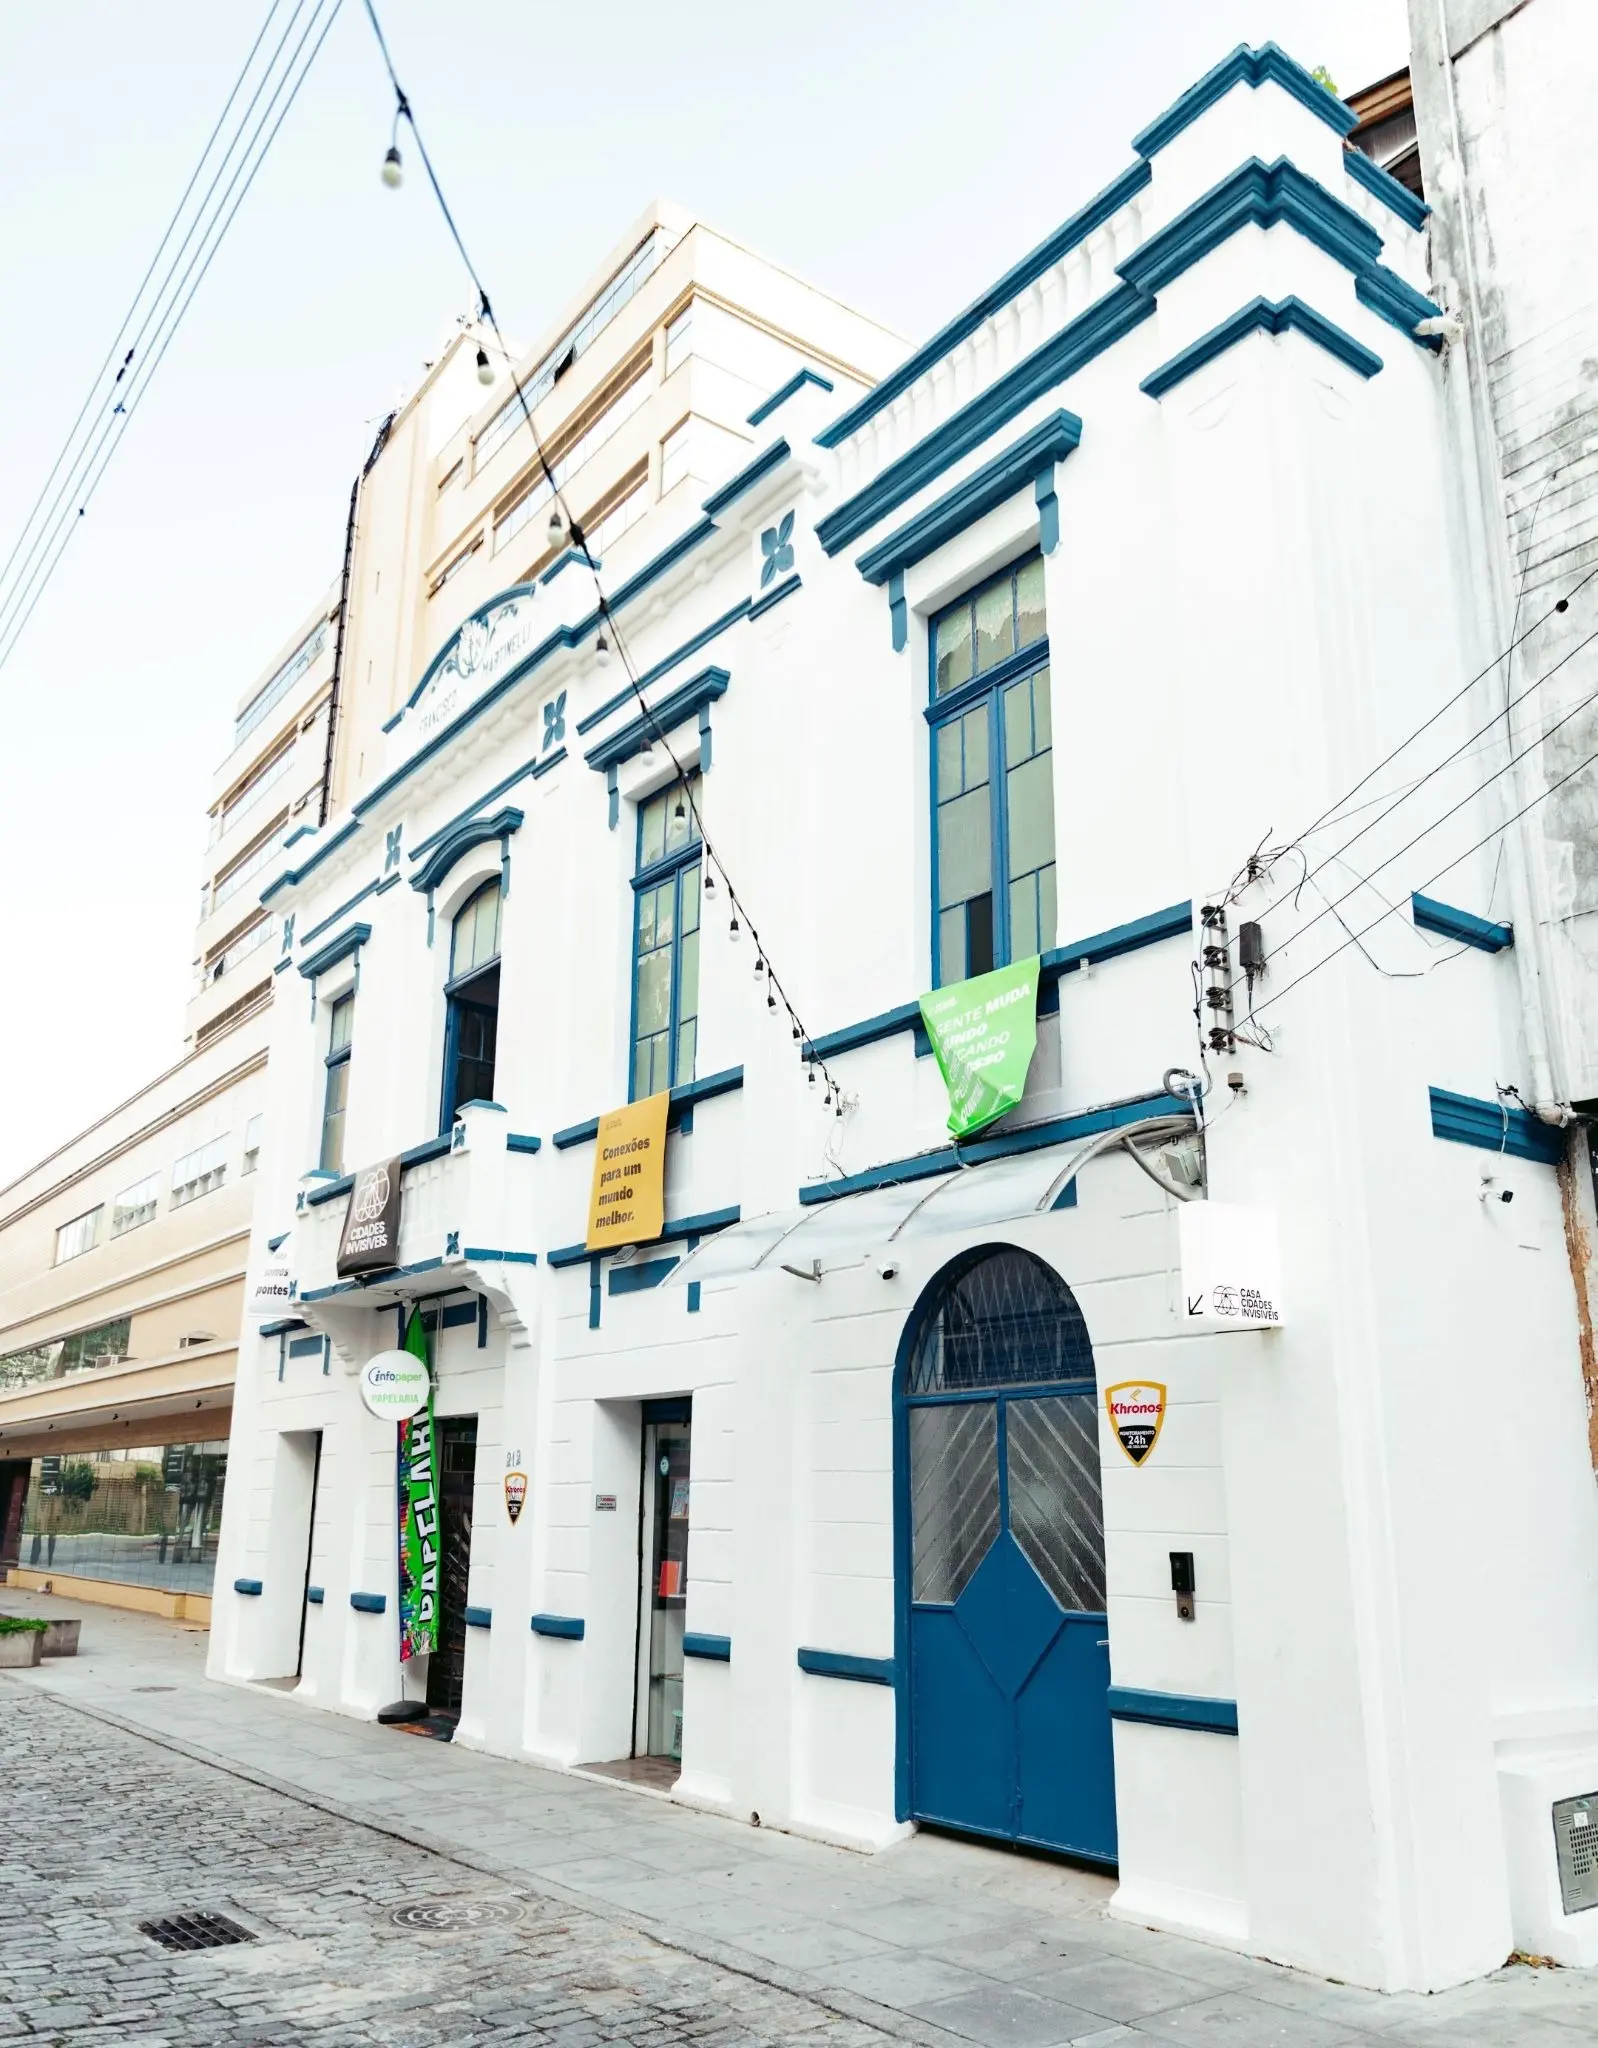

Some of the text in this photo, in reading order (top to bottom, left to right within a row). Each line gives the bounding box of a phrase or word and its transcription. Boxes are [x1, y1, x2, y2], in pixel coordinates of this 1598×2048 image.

[483, 622, 531, 671] MARTINELLI
[985, 984, 1030, 1013] MUDA
[603, 1137, 650, 1161] Conexões
[600, 1162, 641, 1187] para um
[598, 1186, 633, 1206] mundo
[595, 1209, 635, 1229] melhor.
[350, 1221, 386, 1241] CIDADES
[255, 1284, 289, 1297] pontes
[1240, 1288, 1261, 1299] CASA
[1241, 1298, 1273, 1311] CIDADES
[374, 1370, 422, 1384] infopaper
[372, 1393, 419, 1403] PAPELARIA
[1110, 1403, 1164, 1415] Khronos
[1128, 1435, 1146, 1445] 24h
